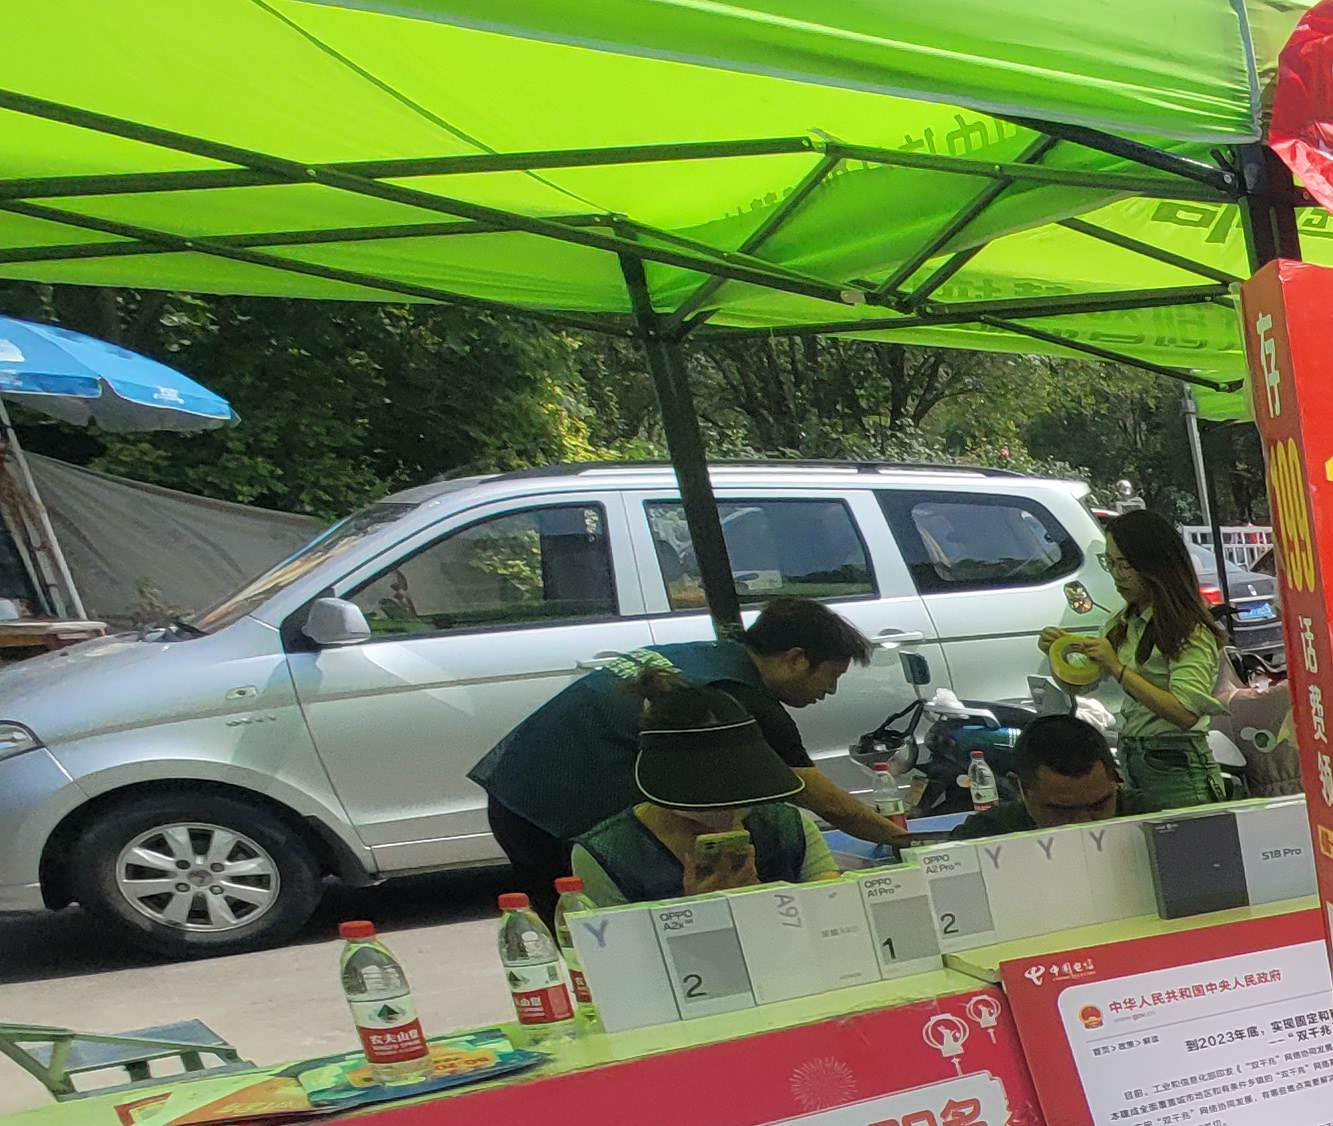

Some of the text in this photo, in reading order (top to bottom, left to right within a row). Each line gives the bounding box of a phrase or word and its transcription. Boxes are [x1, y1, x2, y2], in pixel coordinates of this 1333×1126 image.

[1257, 312, 1281, 419] 存
[1269, 437, 1316, 593] 199
[923, 853, 950, 865] OPPO
[1262, 847, 1301, 861] S18 Pro
[864, 878, 892, 889] OPPO
[659, 909, 693, 923] OPPO
[774, 893, 803, 929] A97
[940, 912, 959, 935] 2
[882, 937, 896, 959] 1
[683, 974, 707, 998] 2
[1108, 969, 1282, 1015] 中华人民共和国中央人民政府
